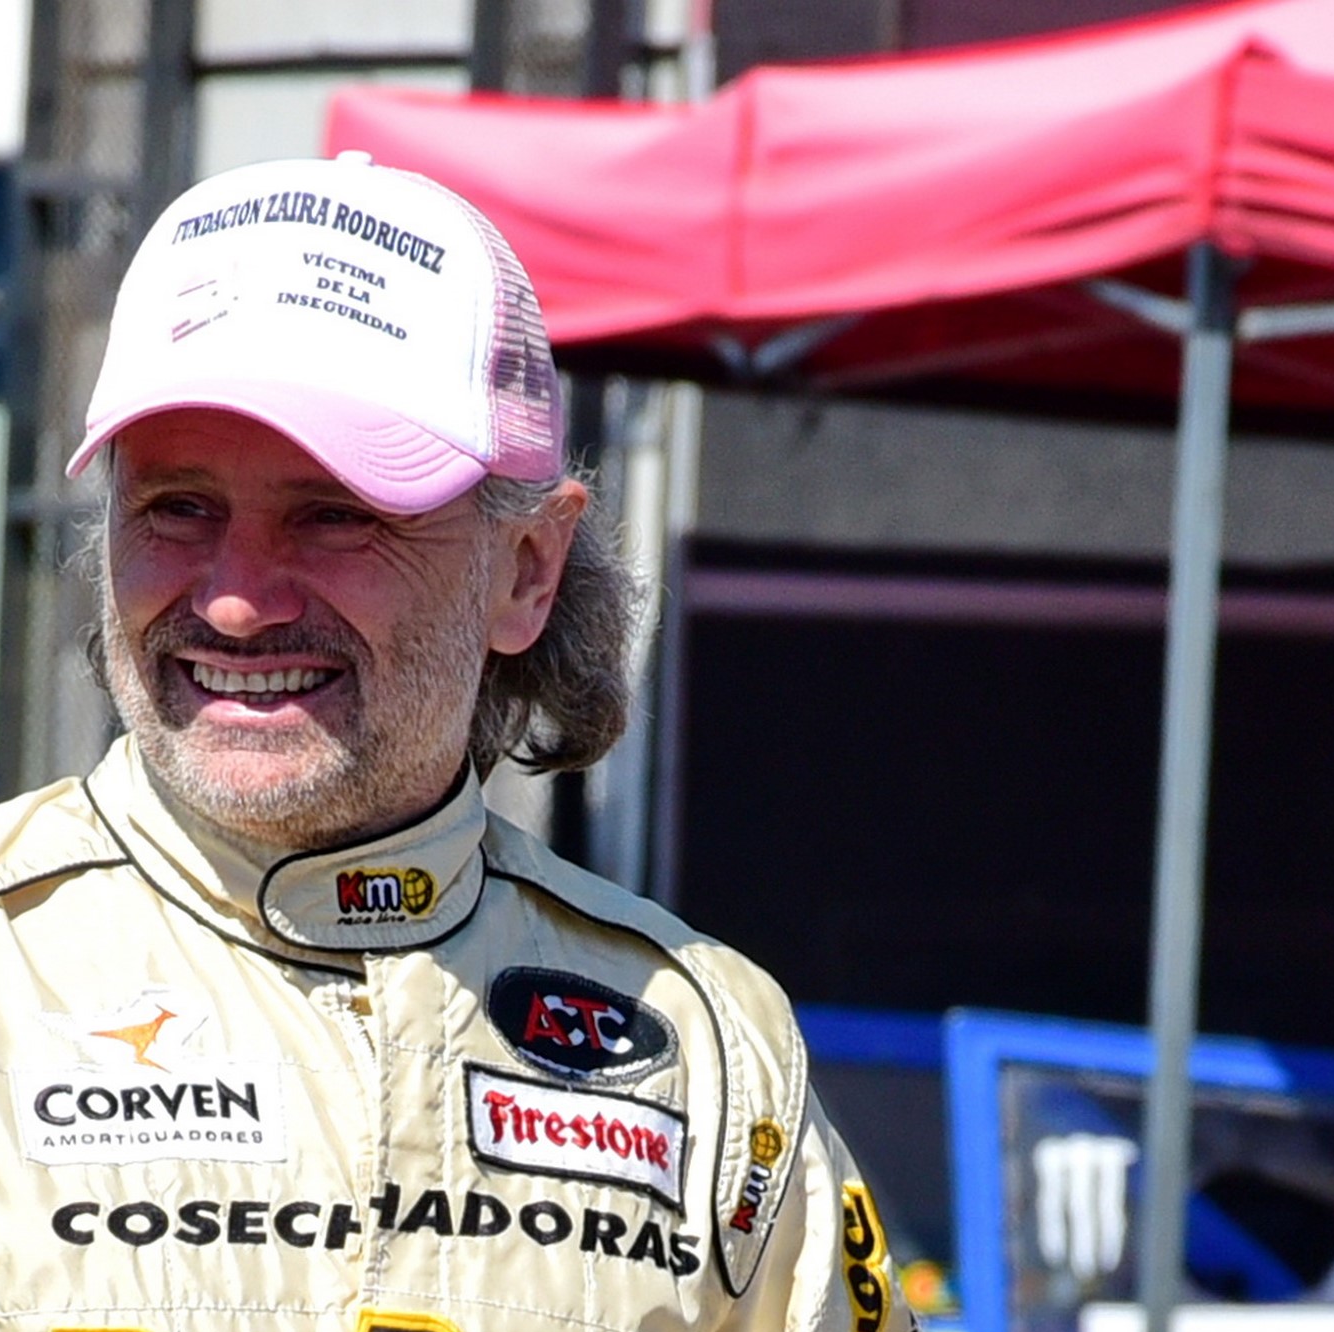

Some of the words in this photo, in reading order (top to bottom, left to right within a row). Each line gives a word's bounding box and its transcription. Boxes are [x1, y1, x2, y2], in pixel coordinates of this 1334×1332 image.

[263, 191, 331, 226] ZAIRA
[331, 202, 446, 275] RODRIGUEZ
[317, 277, 344, 294] DE
[348, 286, 371, 304] LA
[276, 292, 408, 340] INSEGURIDAD
[34, 1078, 261, 1126] CORVEN
[43, 1130, 264, 1148] AMORTIGUADORES
[482, 1089, 670, 1171] Firestone
[52, 1184, 701, 1277] COSECHADORAS
